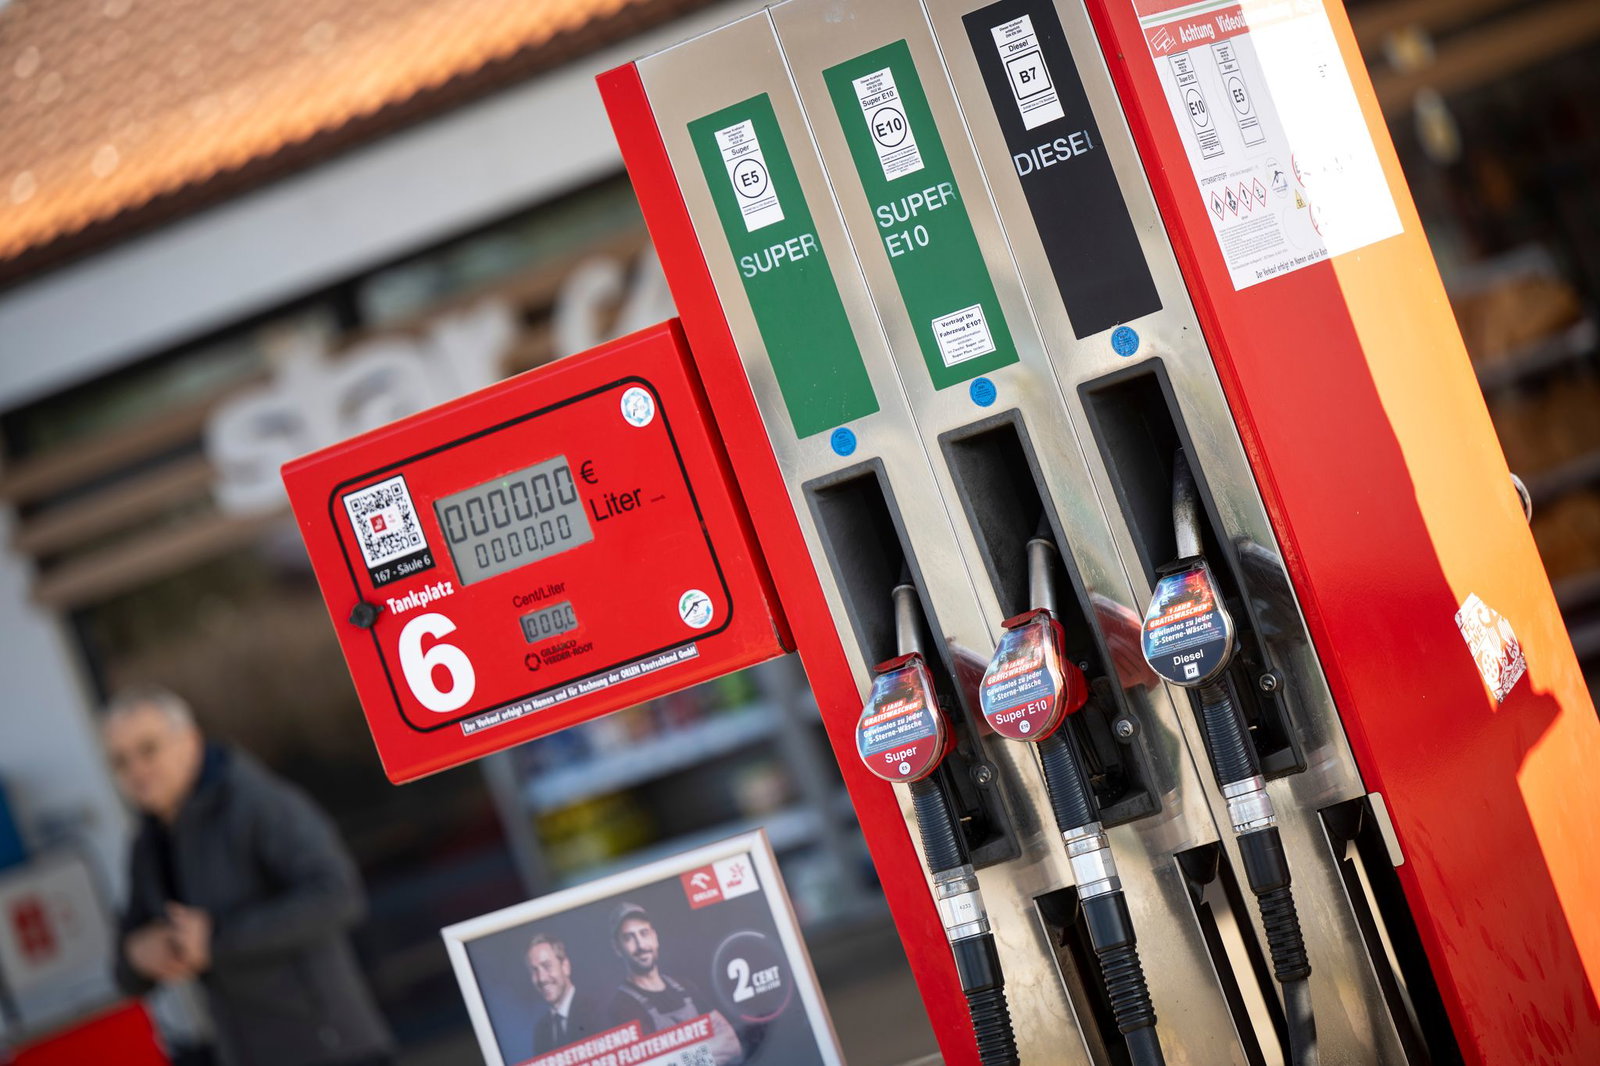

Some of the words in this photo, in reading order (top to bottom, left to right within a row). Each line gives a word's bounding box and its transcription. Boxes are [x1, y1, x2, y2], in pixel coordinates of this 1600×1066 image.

[1179, 23, 1215, 44] Achtung
[1215, 9, 1246, 32] Videoü
[1008, 40, 1029, 52] Diesel
[1019, 66, 1036, 83] B7
[862, 96, 881, 107] Super
[882, 90, 894, 99] E10
[1232, 88, 1245, 103] E5
[1189, 100, 1205, 116] E10
[876, 118, 902, 137] E10
[731, 145, 750, 155] Super
[741, 170, 759, 187] E5
[876, 182, 956, 228] SUPER
[885, 224, 929, 258] E10
[740, 233, 818, 278] SUPER
[940, 325, 965, 338] Fahrzeug
[966, 319, 981, 328] E10?
[579, 460, 598, 485] €
[444, 466, 577, 544] 0000,00
[590, 488, 642, 521] Liter
[475, 514, 572, 569] 0000,00
[375, 569, 391, 583] 167
[397, 559, 423, 575] Säule
[423, 554, 431, 565] 6
[386, 581, 454, 615] Tankplatz
[512, 582, 565, 608] Cent/Liter
[1149, 623, 1184, 640] Gewinnlos
[1195, 613, 1213, 624] jeder
[1155, 622, 1212, 646] 5-Sterne-Wäsche
[540, 639, 577, 657] GILBARCO
[543, 642, 593, 665] VEEDER-ROOT
[1173, 649, 1204, 665] Diesel
[398, 612, 476, 713] 6
[1026, 670, 1042, 682] jeder
[464, 723, 475, 732] Der
[476, 712, 500, 727] Verkauf
[501, 706, 523, 720] erfolgt
[523, 704, 532, 712] im
[532, 696, 555, 708] Namen
[555, 689, 567, 701] und
[567, 687, 578, 696] für
[578, 677, 608, 692] Rechnung
[608, 673, 619, 683] der
[620, 665, 640, 678] ORLEN
[640, 652, 678, 672] Deutschland
[678, 646, 696, 658] GmbH
[996, 710, 1025, 724] Super
[1028, 700, 1047, 715] E10
[864, 721, 896, 738] Gewinnlos
[906, 711, 924, 723] jeder
[869, 721, 922, 744] 5-Sterne-Wäsche
[885, 747, 917, 763] Super
[727, 958, 755, 1003] 2
[752, 965, 779, 986] CENT
